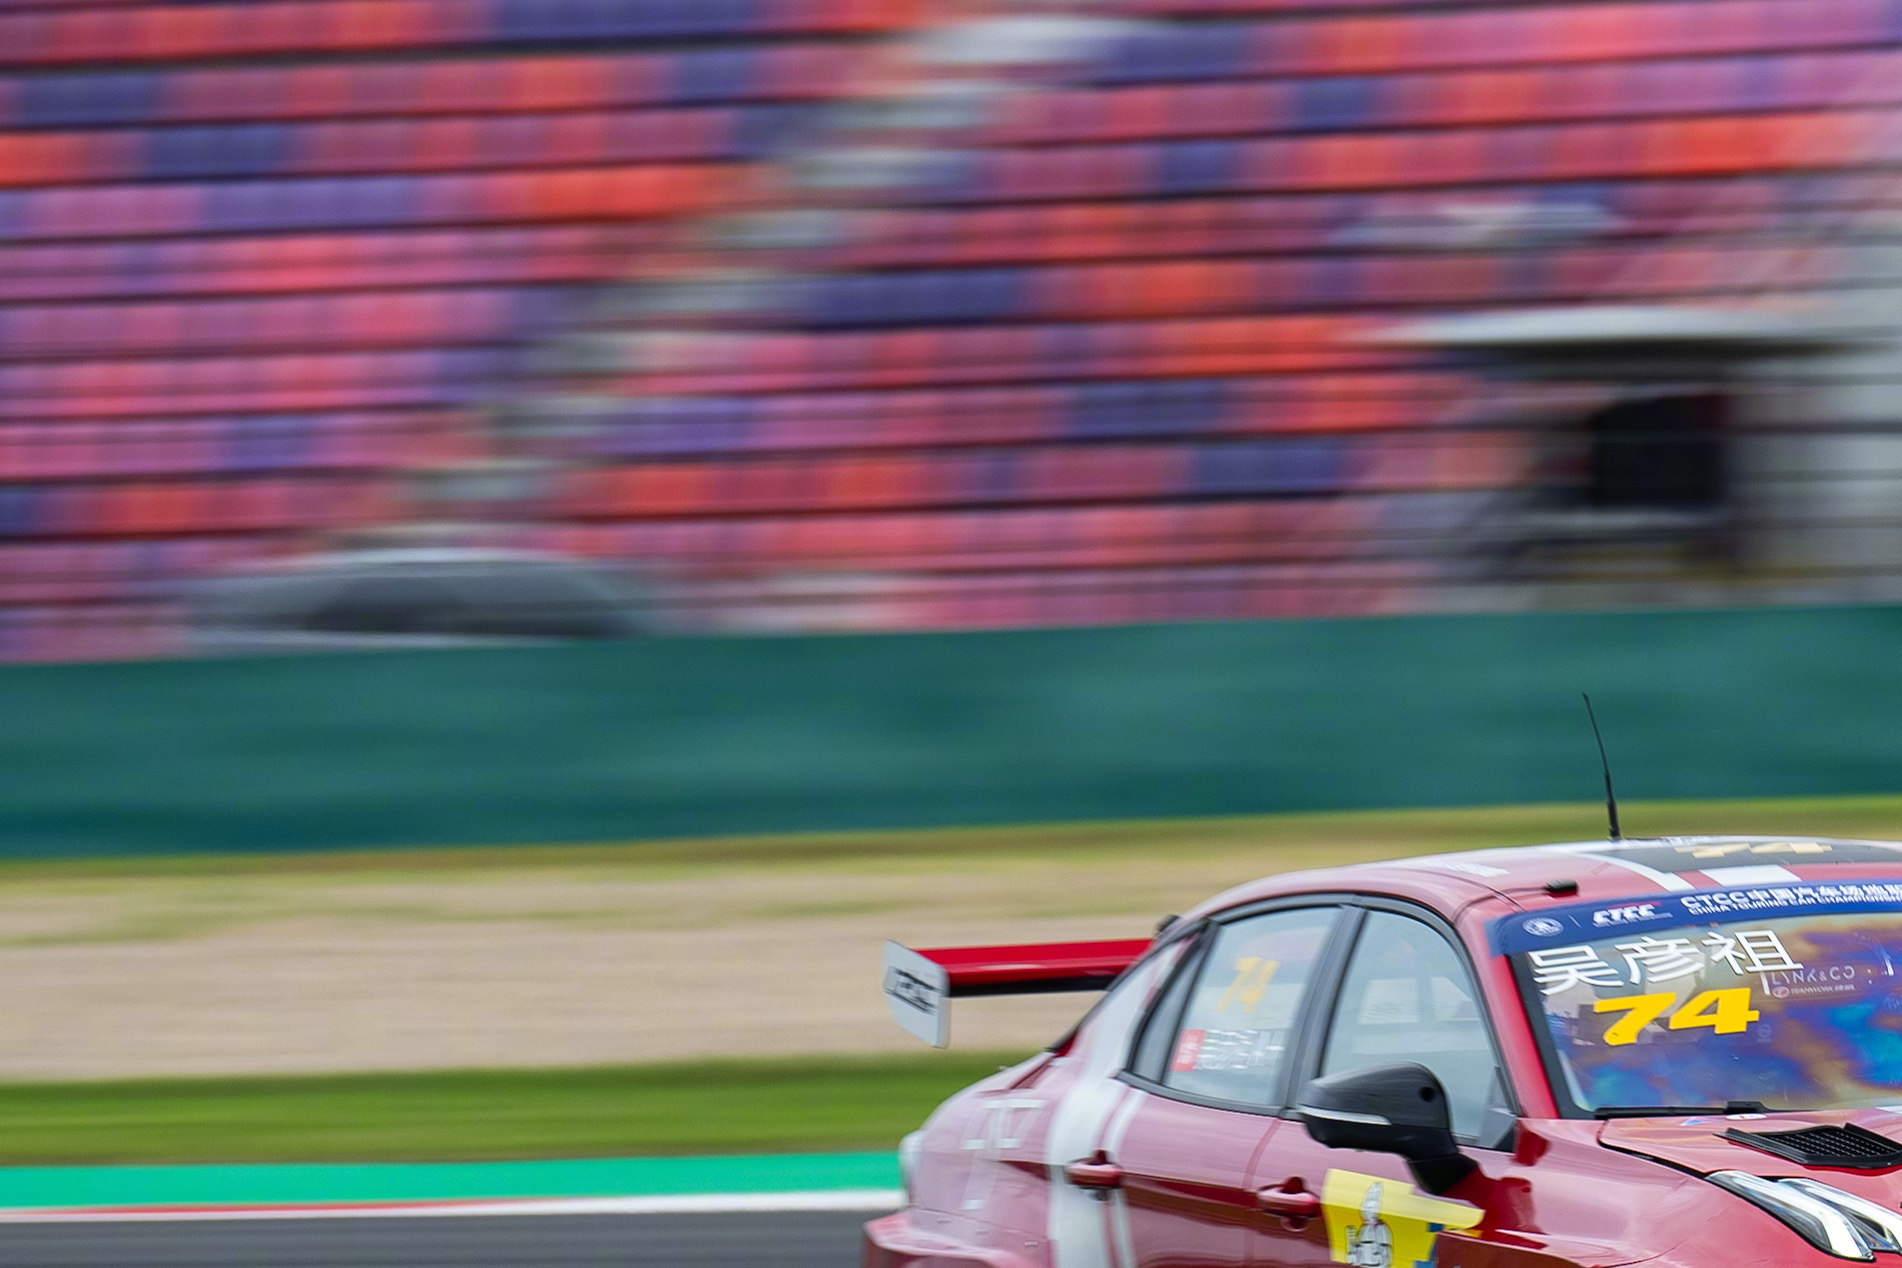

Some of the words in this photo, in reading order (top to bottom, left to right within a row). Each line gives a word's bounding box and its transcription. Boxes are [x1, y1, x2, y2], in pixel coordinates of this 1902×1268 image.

[1528, 929, 1804, 995] 吴彦祖
[1593, 988, 1760, 1046] 74
